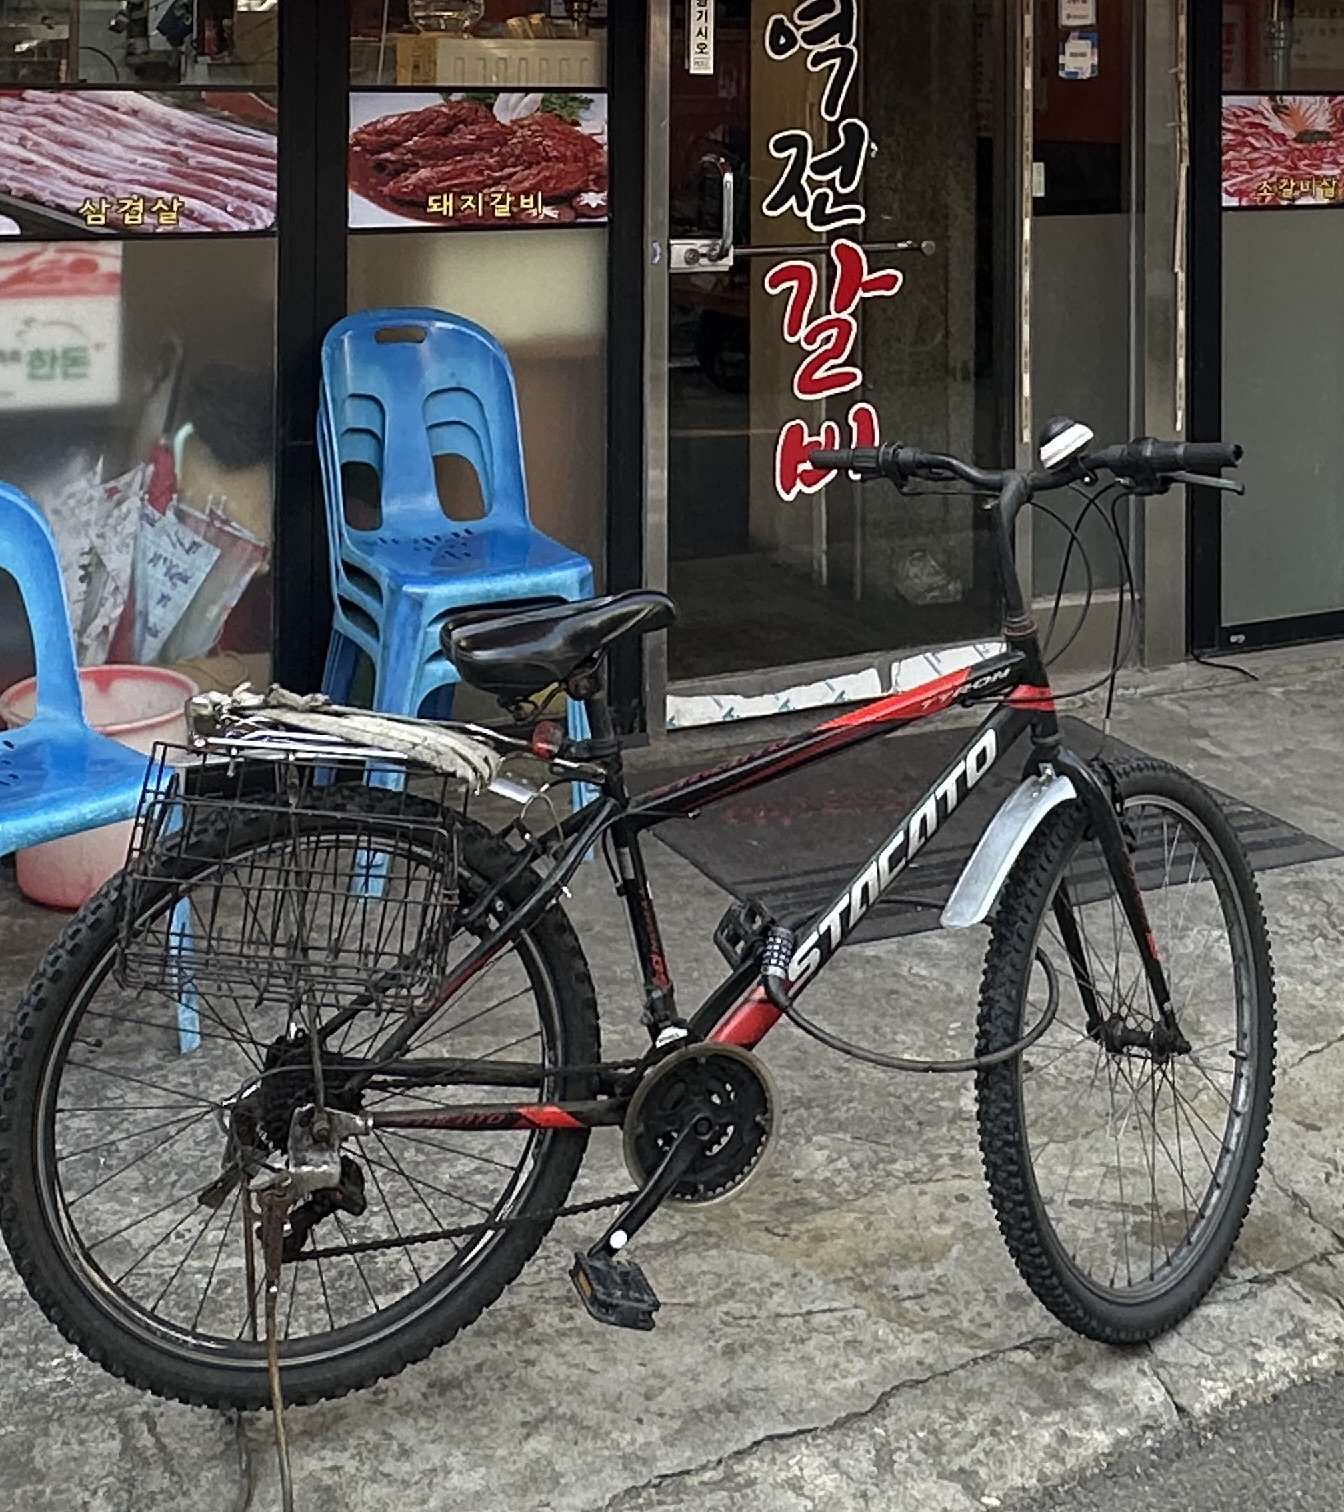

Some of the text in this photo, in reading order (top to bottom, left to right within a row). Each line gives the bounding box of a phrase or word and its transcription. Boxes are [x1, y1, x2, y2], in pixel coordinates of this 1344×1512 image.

[1257, 177, 1338, 199] 소갈비살
[78, 194, 186, 227] 삼겹살
[426, 191, 545, 219] 돼지갈비
